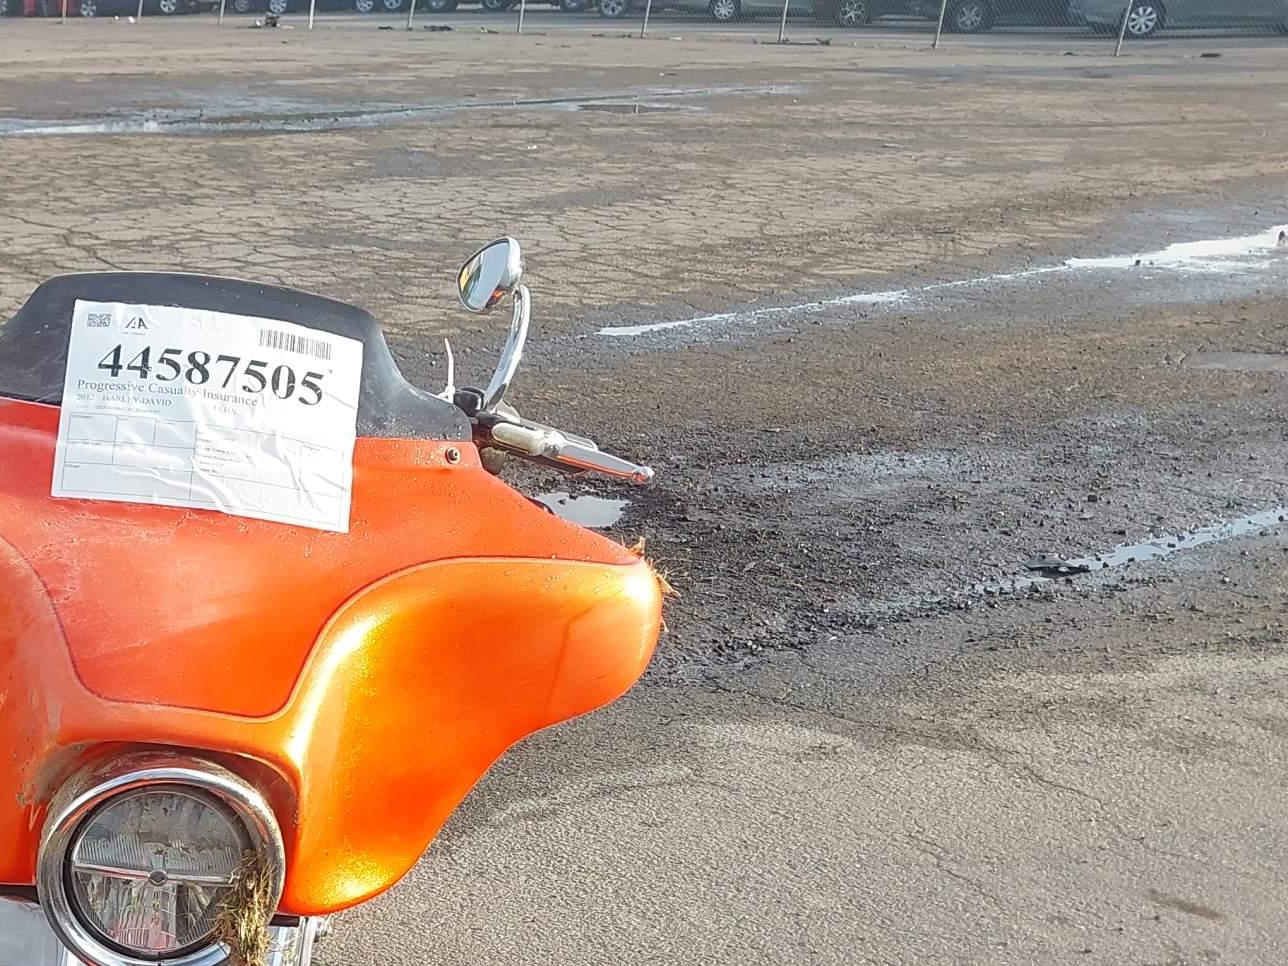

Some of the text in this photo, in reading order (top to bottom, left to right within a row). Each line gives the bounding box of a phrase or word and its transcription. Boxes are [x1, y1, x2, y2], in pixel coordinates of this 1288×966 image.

[77, 379, 258, 407] Progressive Casualty Insurance
[97, 344, 325, 406] 44587505
